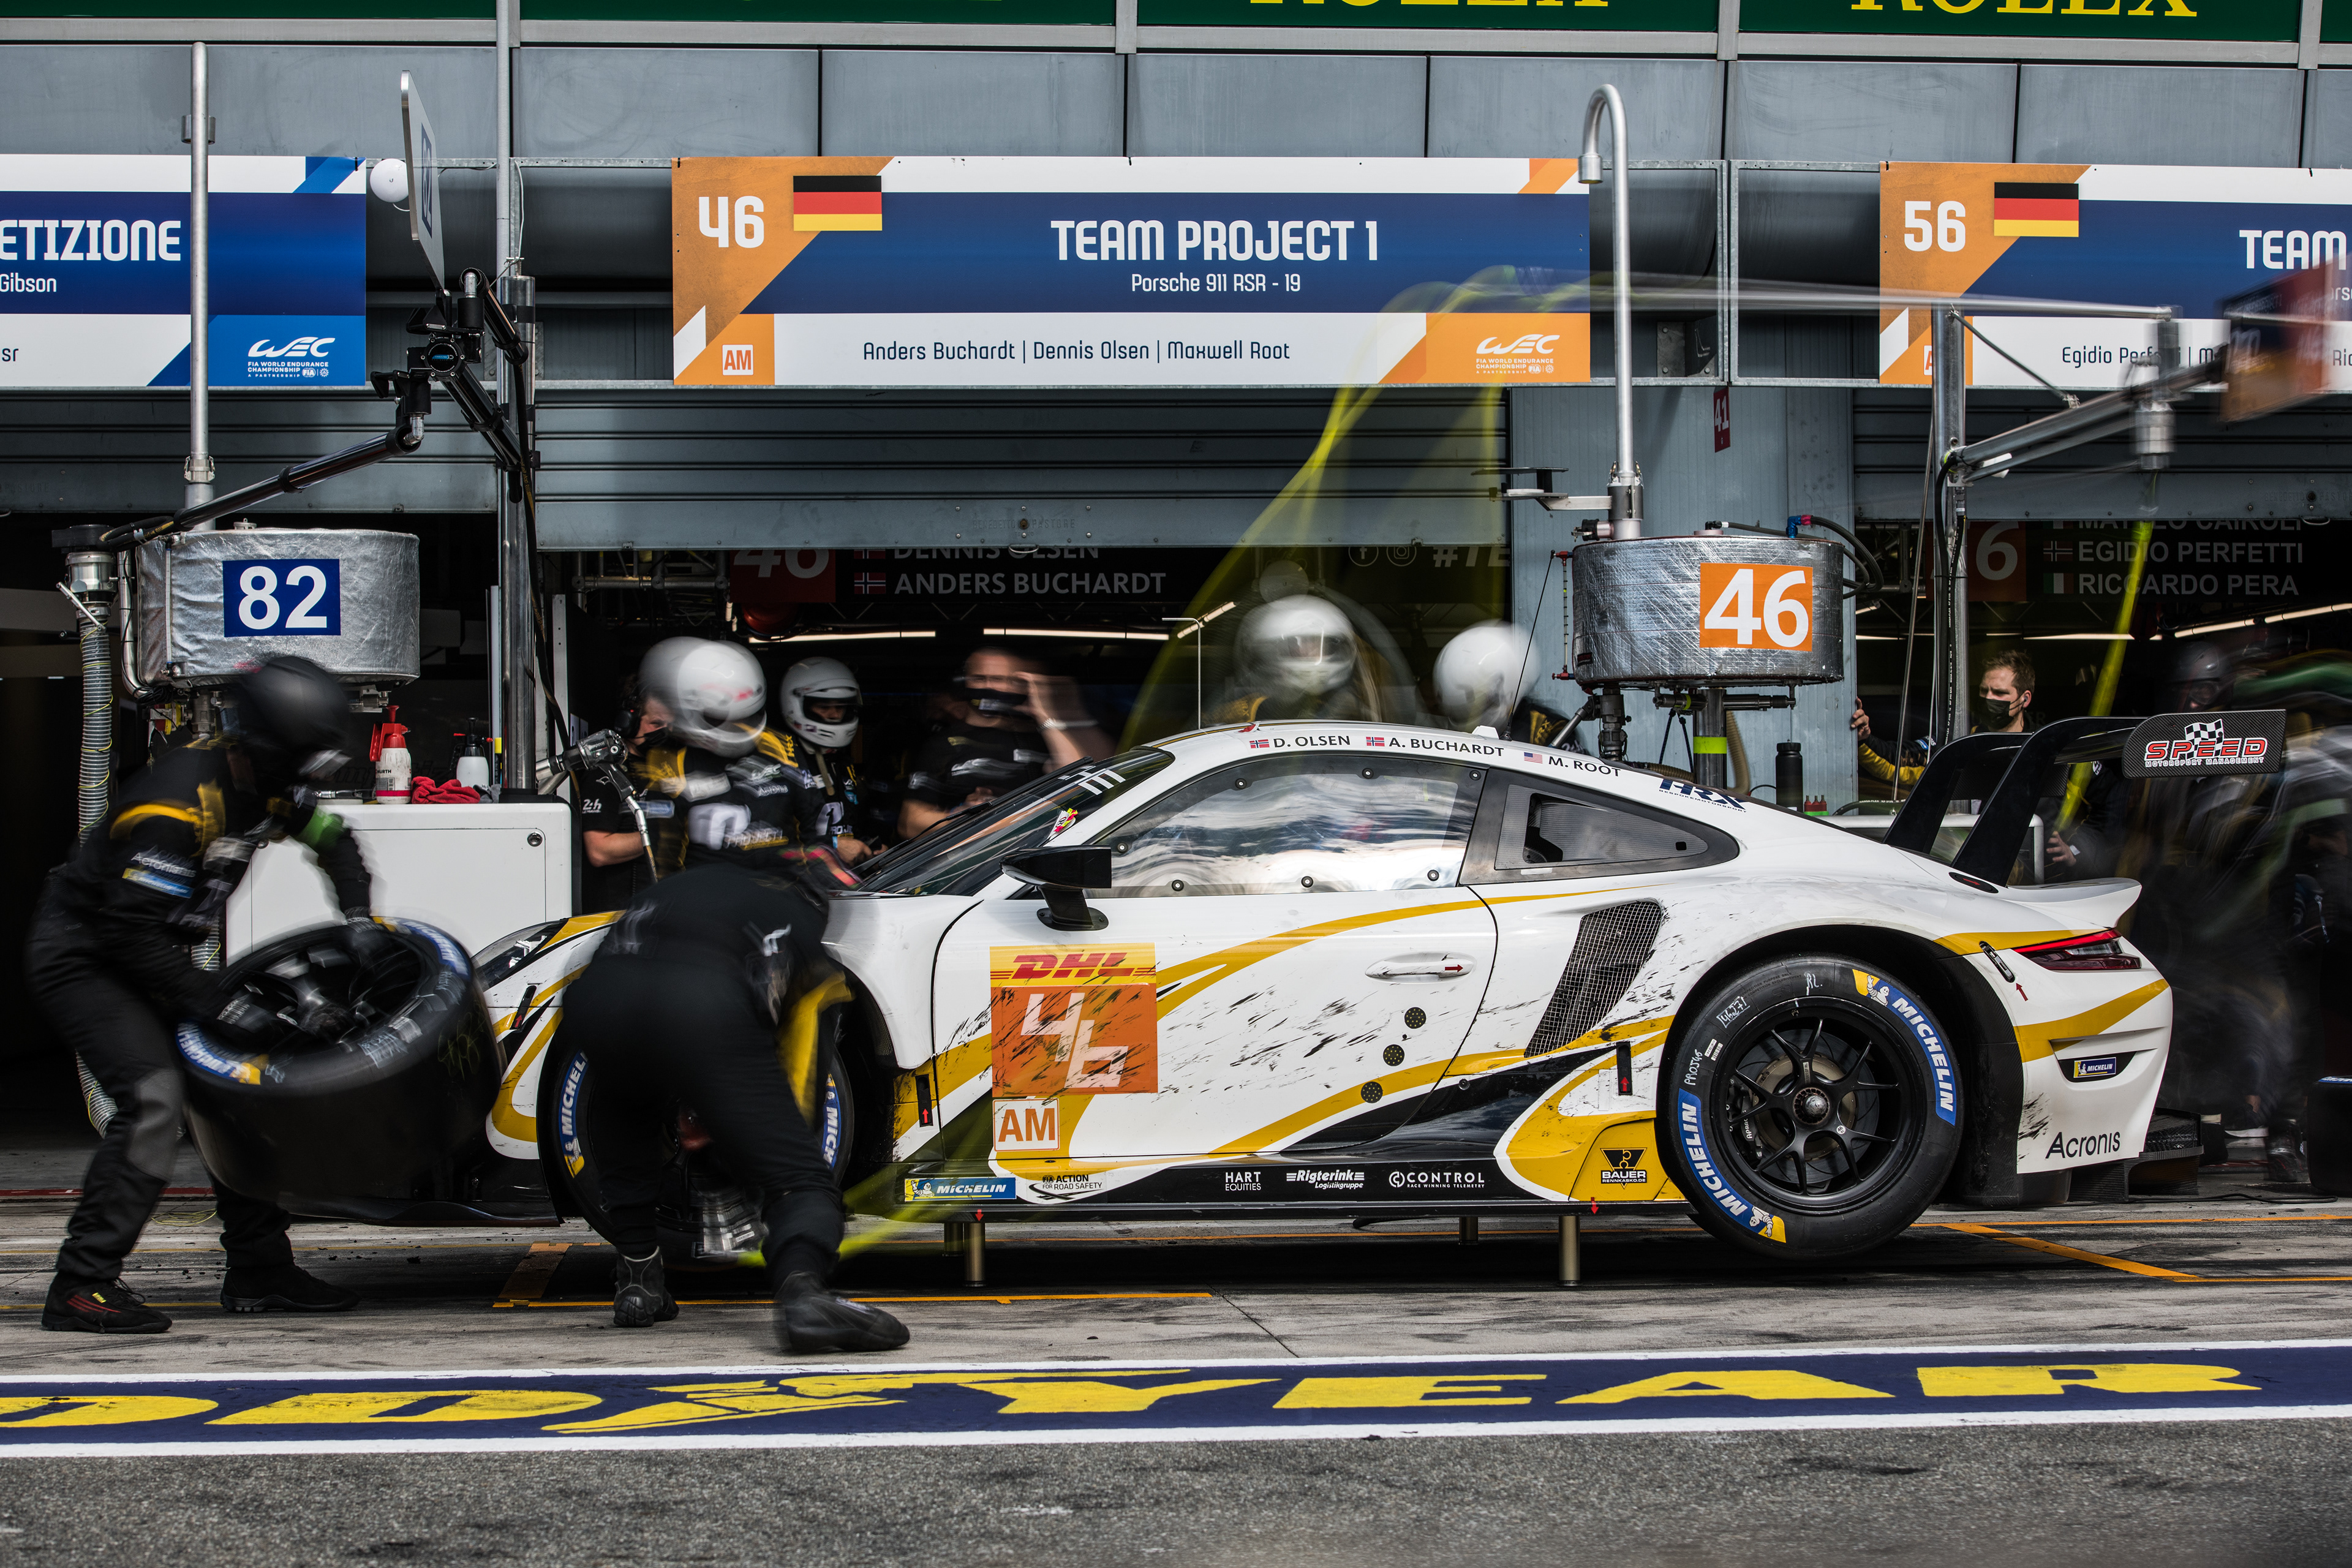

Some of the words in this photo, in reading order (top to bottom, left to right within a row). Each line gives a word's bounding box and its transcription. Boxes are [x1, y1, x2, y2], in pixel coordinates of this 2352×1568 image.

[699, 195, 764, 249] 46
[1904, 200, 1966, 252] 56
[1051, 220, 1164, 261] TEAM
[1179, 221, 1354, 261] PROJECT
[1365, 221, 1378, 261] 1
[2239, 230, 2346, 270] TEAM
[0, 273, 57, 292] Gibson
[1132, 273, 1200, 292] Porsche
[1206, 273, 1228, 292] 911
[1234, 273, 1266, 292] RSR
[1284, 273, 1301, 292] 19
[248, 336, 336, 358] WEC
[863, 341, 926, 360] Anders
[933, 341, 1015, 360] Buchardt
[1033, 341, 1093, 360] Dennis
[1101, 341, 1150, 360] Olsen
[1167, 341, 1243, 360] Maxwell
[1251, 341, 1290, 360] Root
[1476, 334, 1560, 354] WEC
[723, 350, 752, 371] AM
[2062, 346, 2112, 368] Egidio
[1715, 396, 1729, 432] 41
[2081, 541, 2169, 564] EGIDIO
[2177, 540, 2303, 564] PERFETTI
[894, 572, 1006, 595] ANDERS
[1014, 572, 1166, 595] BUCHARDT
[2081, 573, 2218, 596] RICCARDO
[2227, 573, 2299, 596] PERA
[238, 565, 328, 630] 82
[1704, 568, 1809, 647] 46
[1273, 738, 1291, 748] D.
[1295, 736, 1351, 747] OLSEN
[1389, 737, 1405, 748] A.
[1411, 739, 1504, 756] BUCHARDT
[2144, 737, 2267, 761] SPEED
[1548, 756, 1569, 768] M.
[1574, 760, 1621, 777] ROOT
[2145, 759, 2203, 767] MOTORSPORT
[1012, 952, 1134, 979] DHL
[1020, 993, 1129, 1088] 46
[1891, 997, 1954, 1112] MICHELIN
[2087, 1063, 2113, 1072] MICHELIN
[998, 1107, 1055, 1142] AM
[2046, 1131, 2120, 1159] Acronis
[1682, 1102, 1747, 1217] MICHELIN
[1056, 1174, 1089, 1183] ACTION
[1226, 1172, 1261, 1182] HART
[1297, 1170, 1354, 1183] Rigterink
[1315, 1181, 1363, 1190] Logistikgruppe
[1408, 1172, 1485, 1183] CONTROL
[937, 1184, 1007, 1194] MICHELIN
